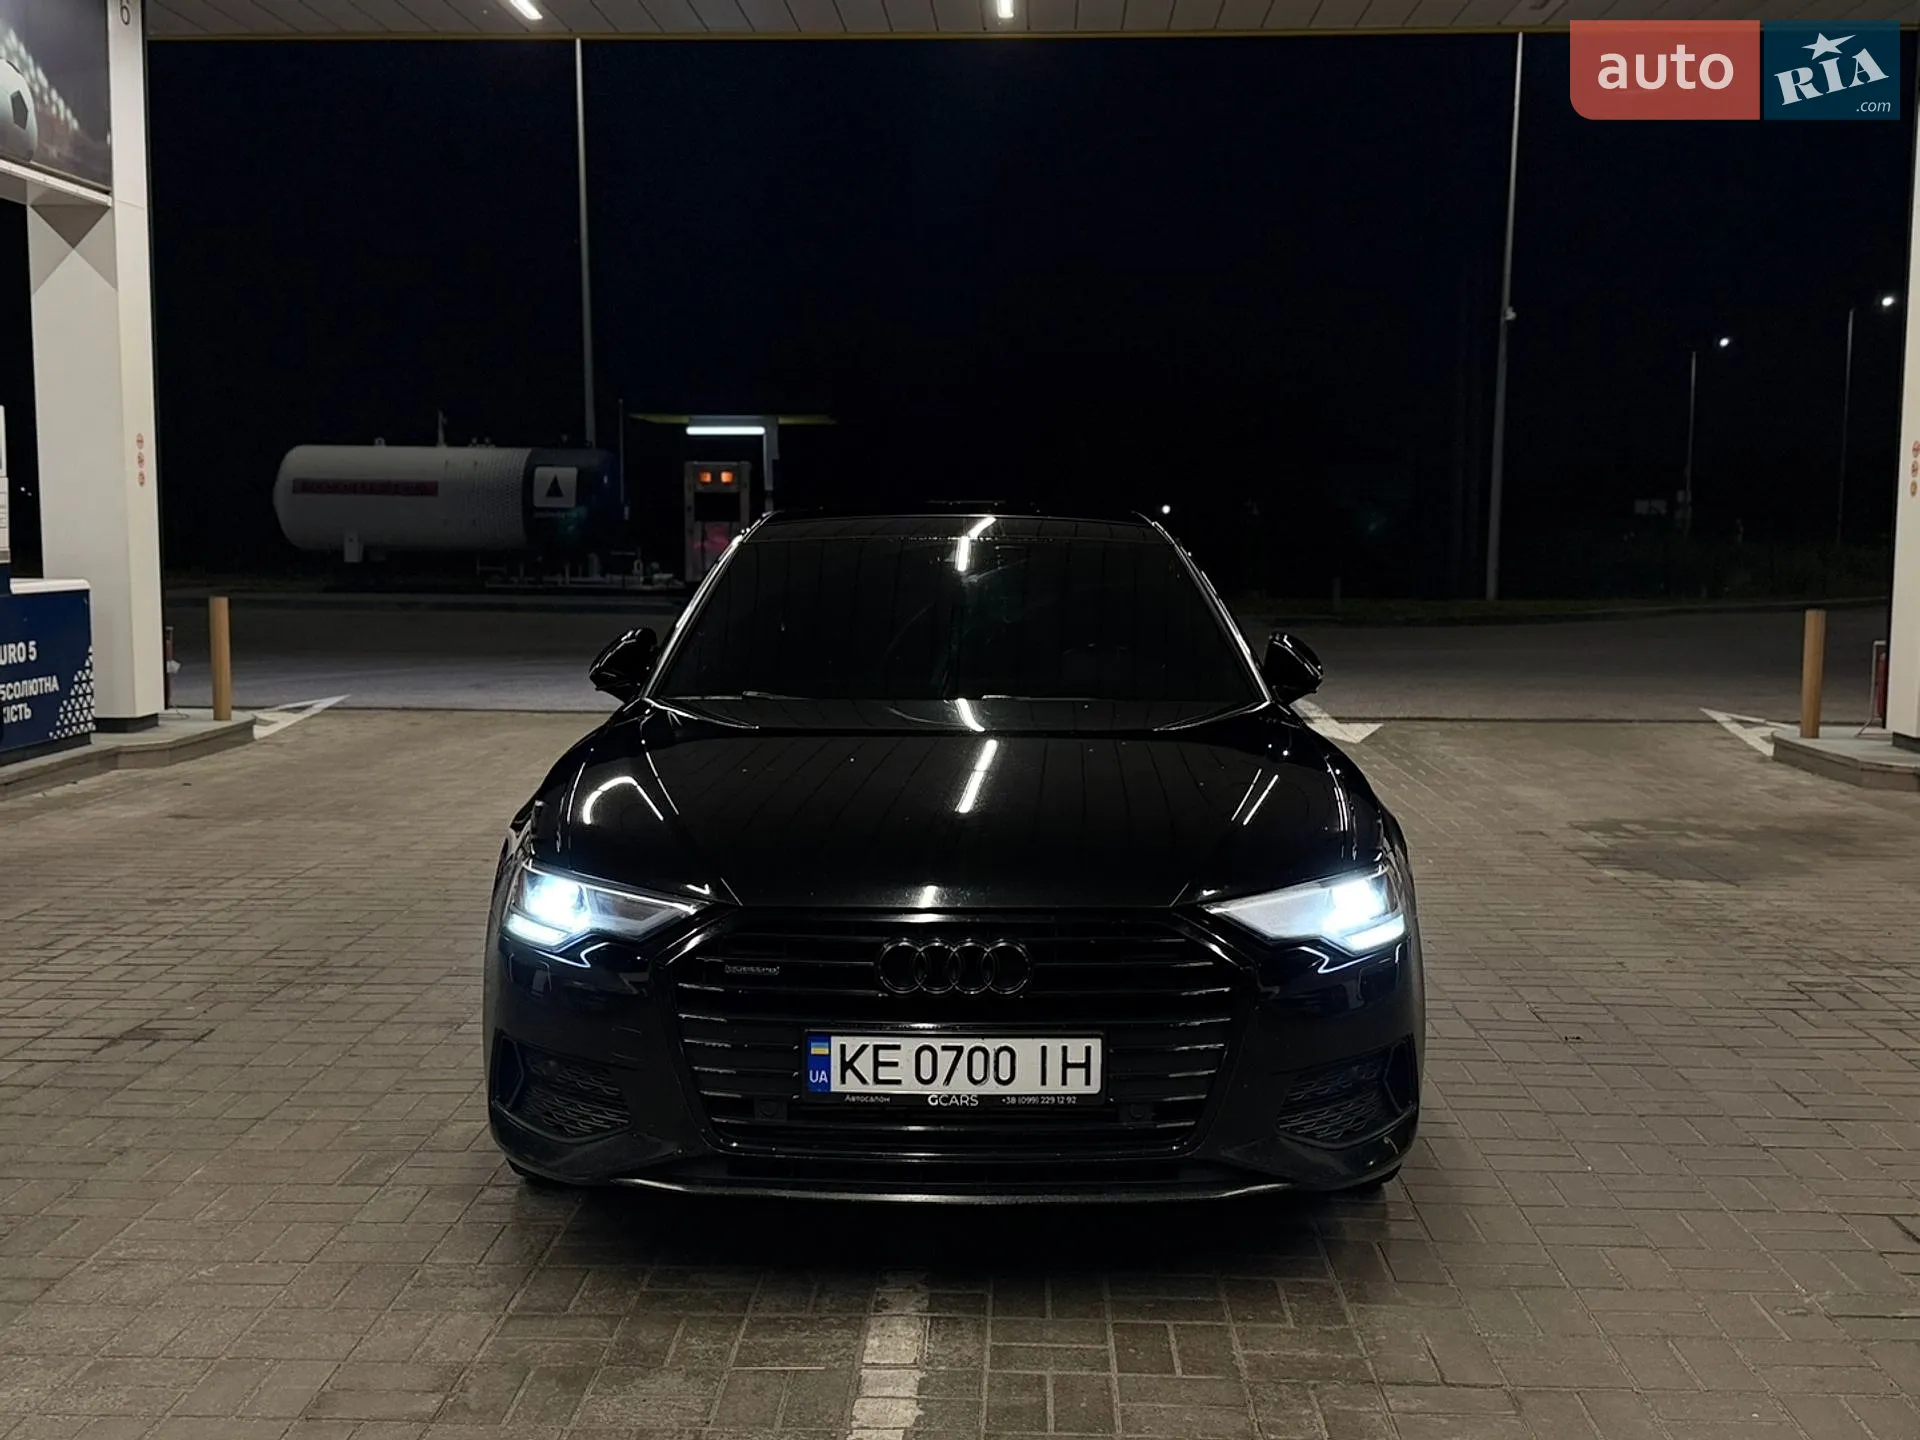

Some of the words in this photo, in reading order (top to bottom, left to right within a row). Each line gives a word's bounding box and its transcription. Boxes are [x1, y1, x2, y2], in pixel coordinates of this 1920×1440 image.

[28, 640, 38, 662] 5
[839, 1043, 902, 1085] KE
[914, 1044, 1017, 1086] 0700
[1040, 1045, 1092, 1086] IH
[809, 1070, 829, 1083] UA
[927, 1094, 979, 1106] GCARS
